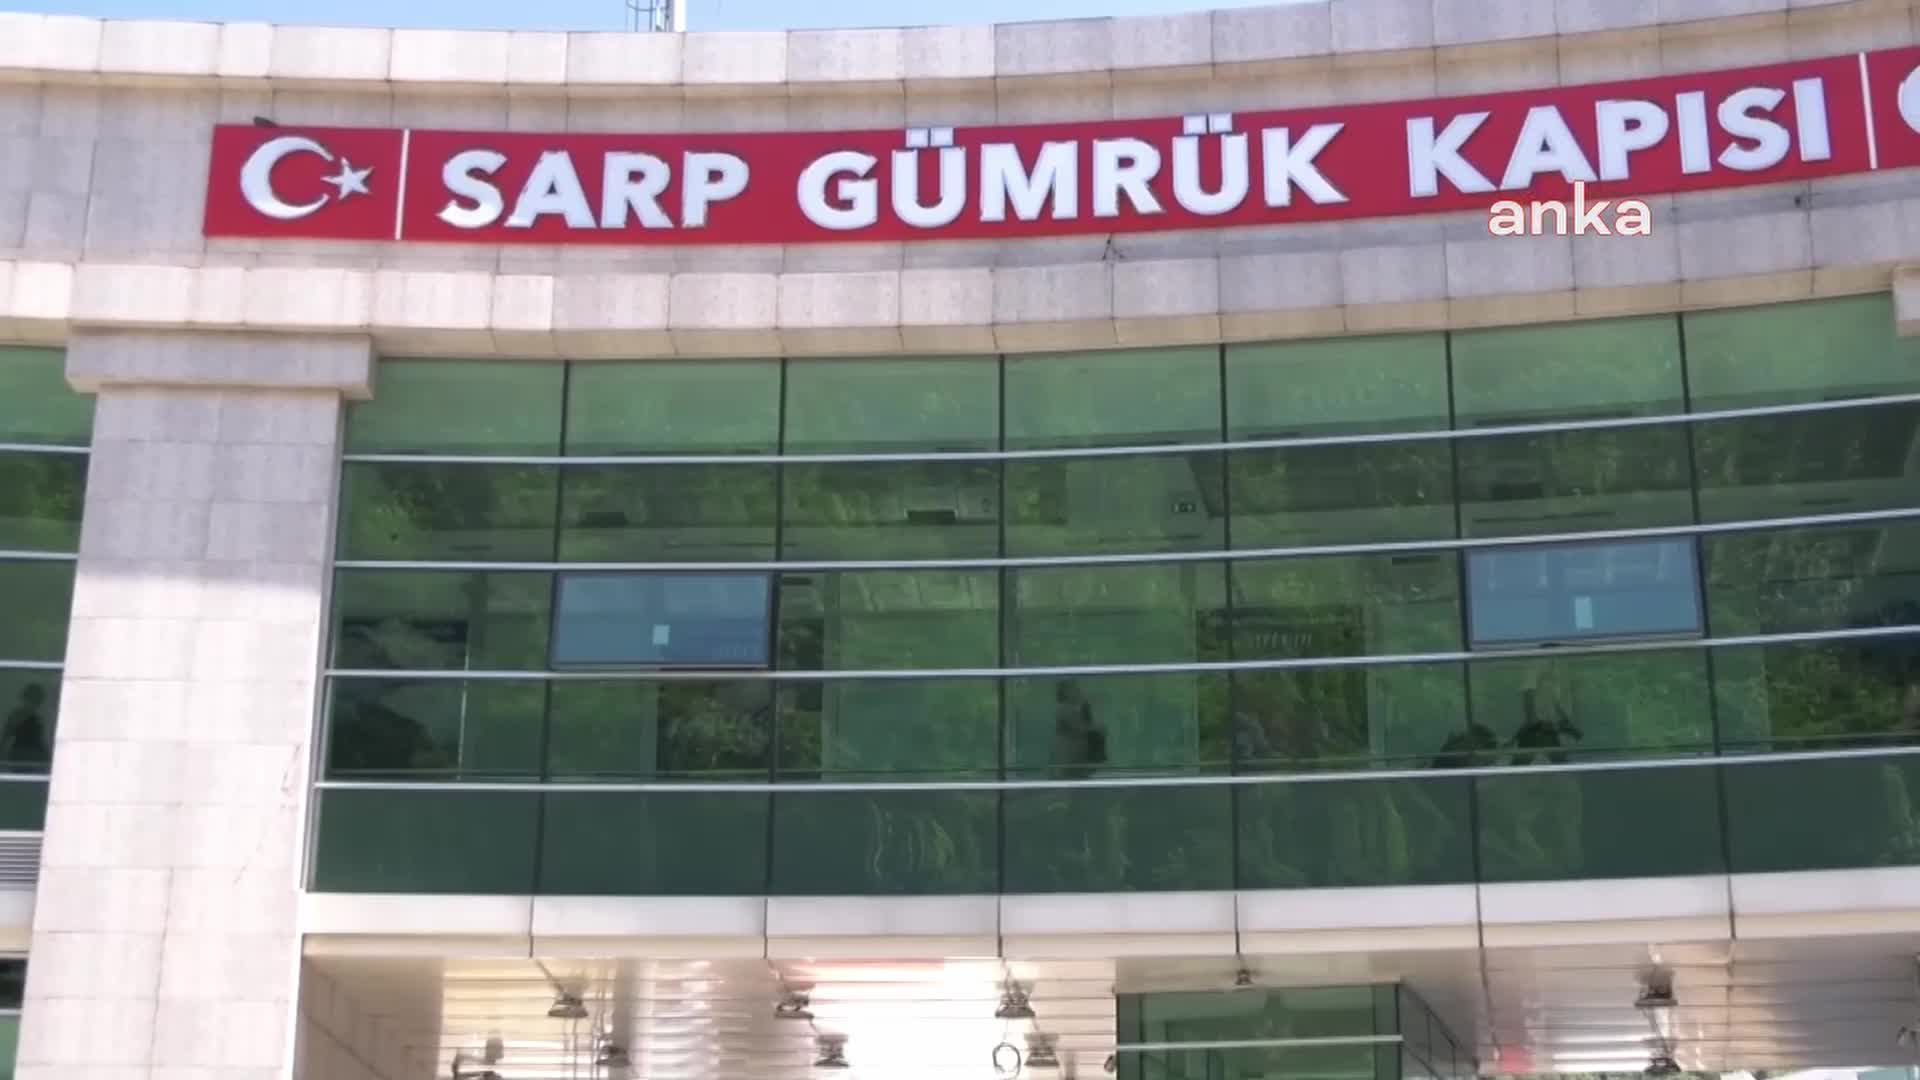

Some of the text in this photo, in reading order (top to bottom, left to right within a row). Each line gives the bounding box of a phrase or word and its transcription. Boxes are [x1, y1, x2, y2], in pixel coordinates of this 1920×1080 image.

[437, 77, 1831, 230] SARP GÜMRÜK KAPISI
